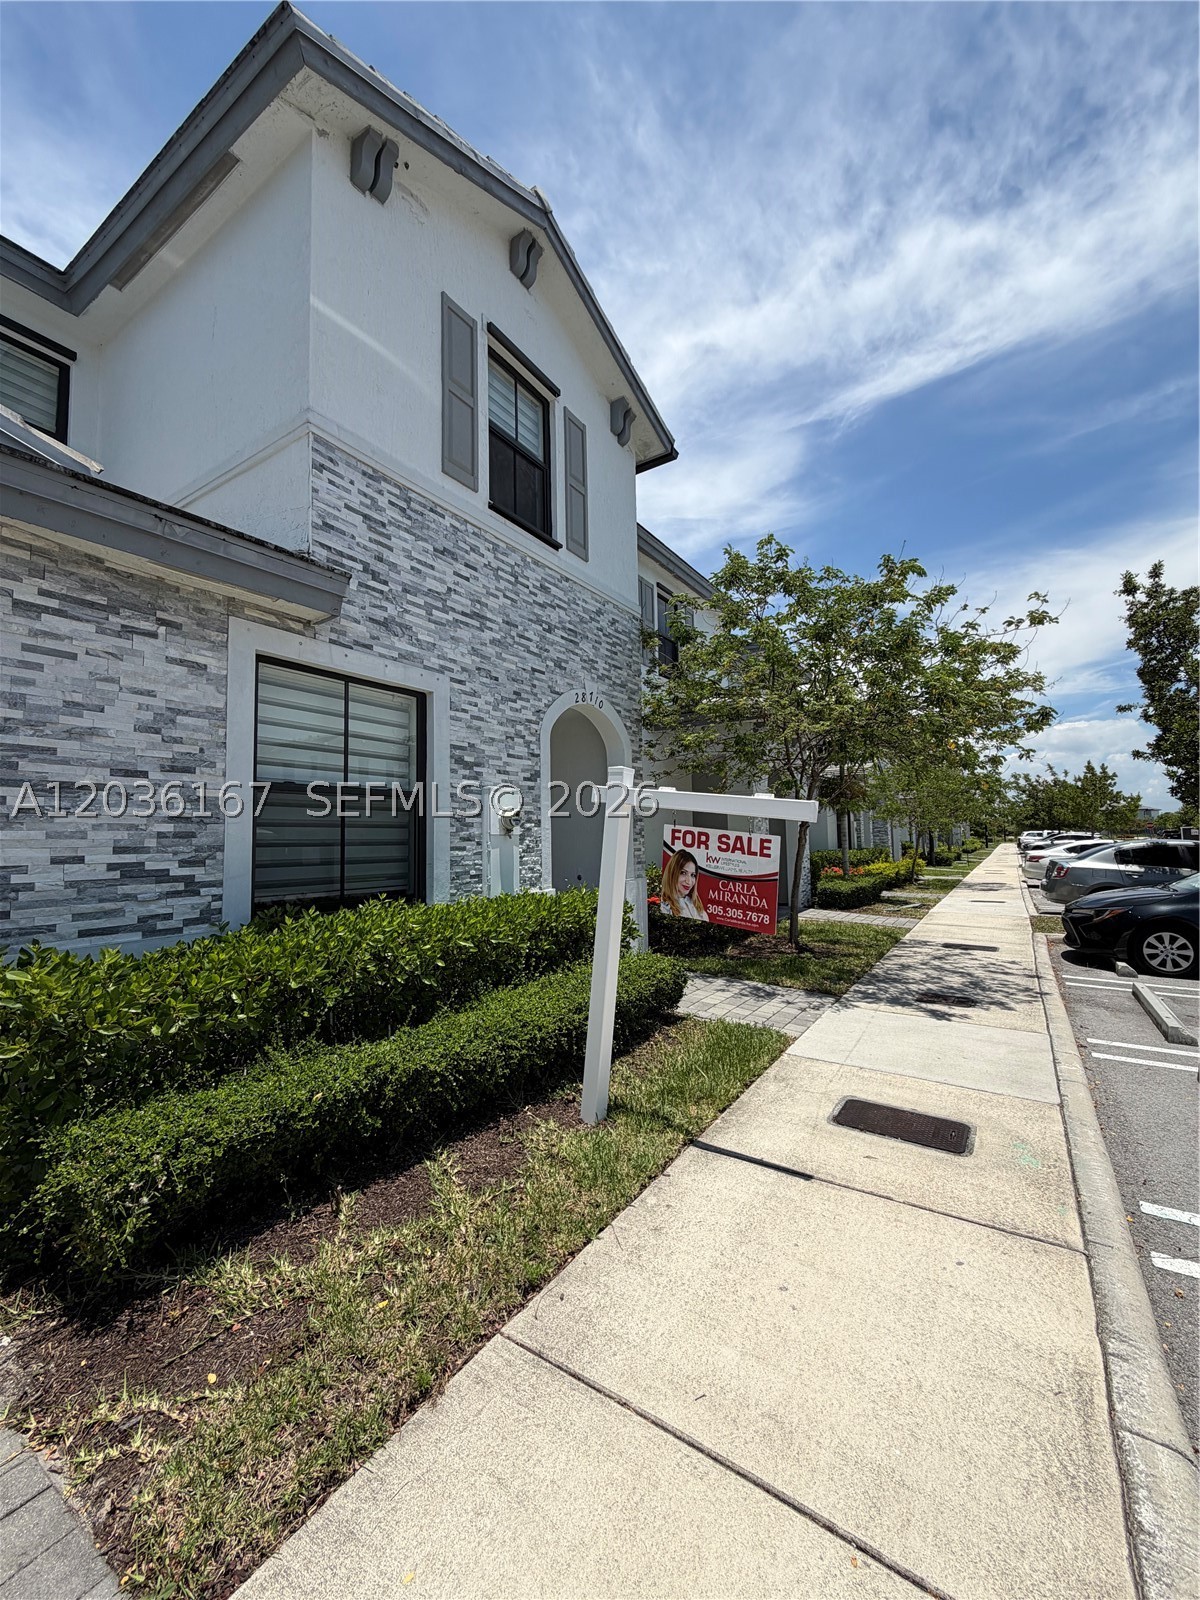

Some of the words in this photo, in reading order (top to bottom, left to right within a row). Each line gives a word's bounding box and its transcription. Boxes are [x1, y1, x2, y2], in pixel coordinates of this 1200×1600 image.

[671, 828, 710, 851] FOR
[717, 833, 773, 859] SALE
[719, 880, 758, 896] CARLA
[708, 889, 769, 909] MIRANDA
[707, 904, 770, 925] 305.305.7678
